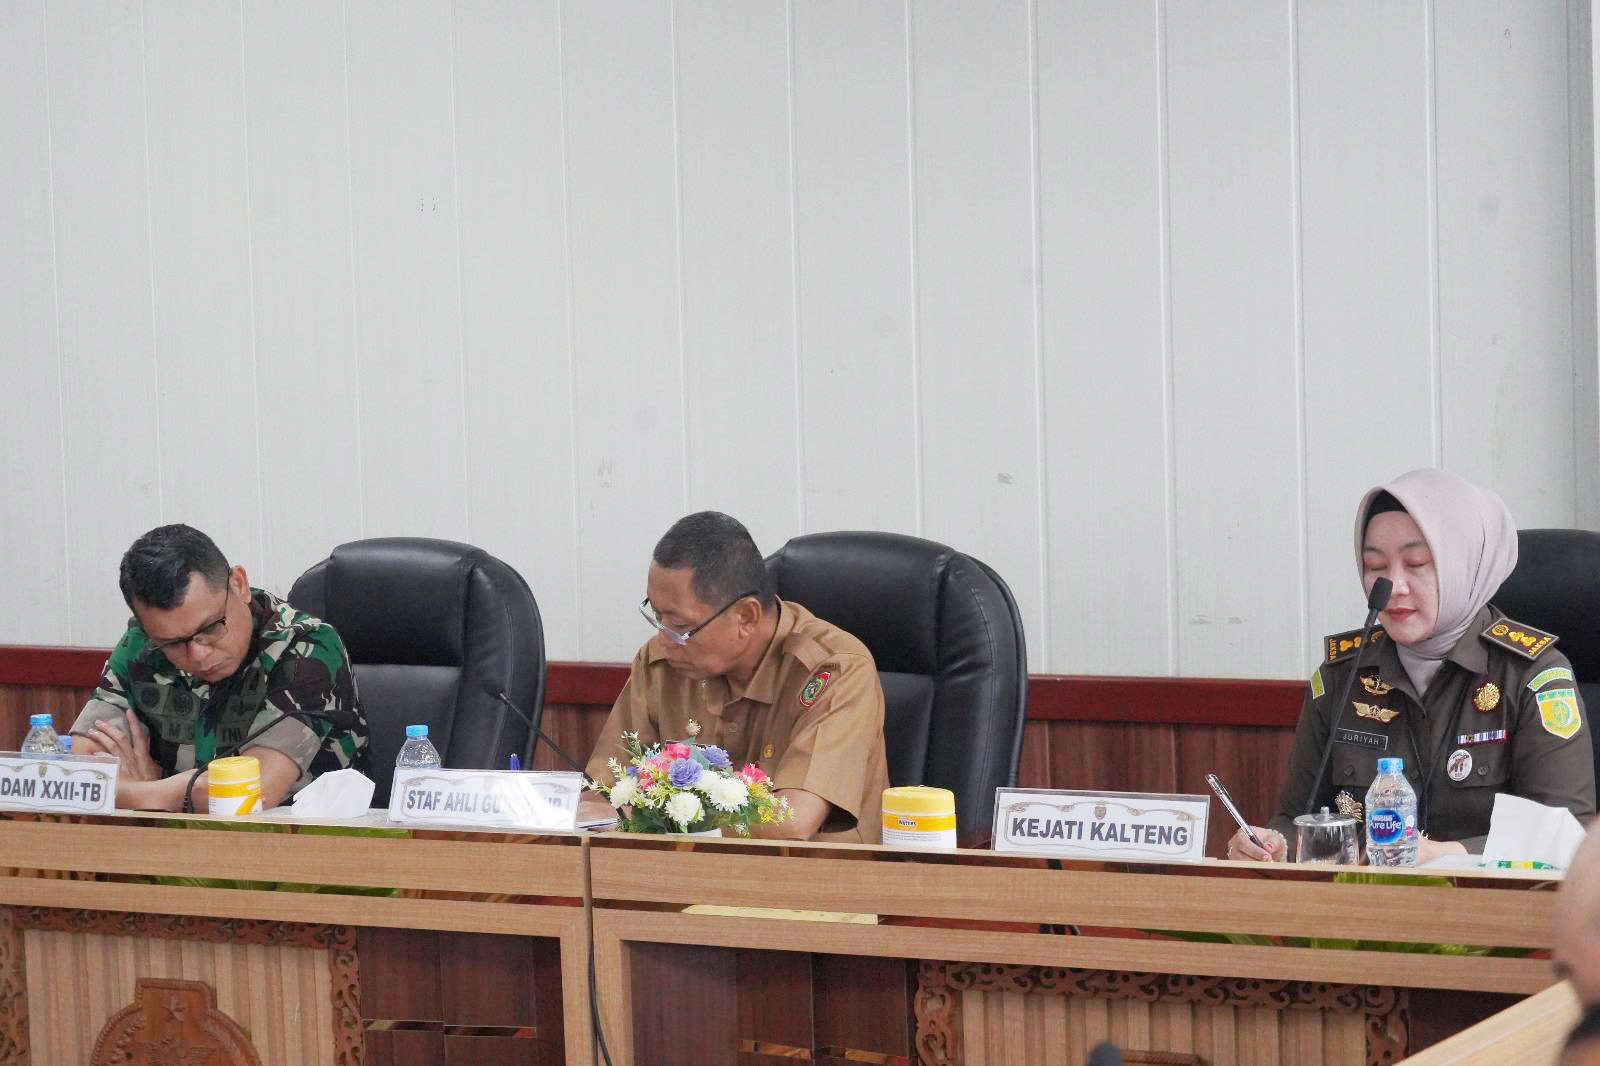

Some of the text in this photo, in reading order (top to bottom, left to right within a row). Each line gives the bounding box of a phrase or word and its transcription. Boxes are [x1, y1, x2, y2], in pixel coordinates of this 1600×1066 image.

[1343, 733, 1379, 745] JURIYAH
[1, 777, 102, 802] DAM XXII-TB
[406, 789, 442, 809] STAF
[444, 792, 478, 812] AHLI
[1012, 817, 1188, 846] KEJATI KALTENG
[1369, 820, 1402, 832] Pure Life
